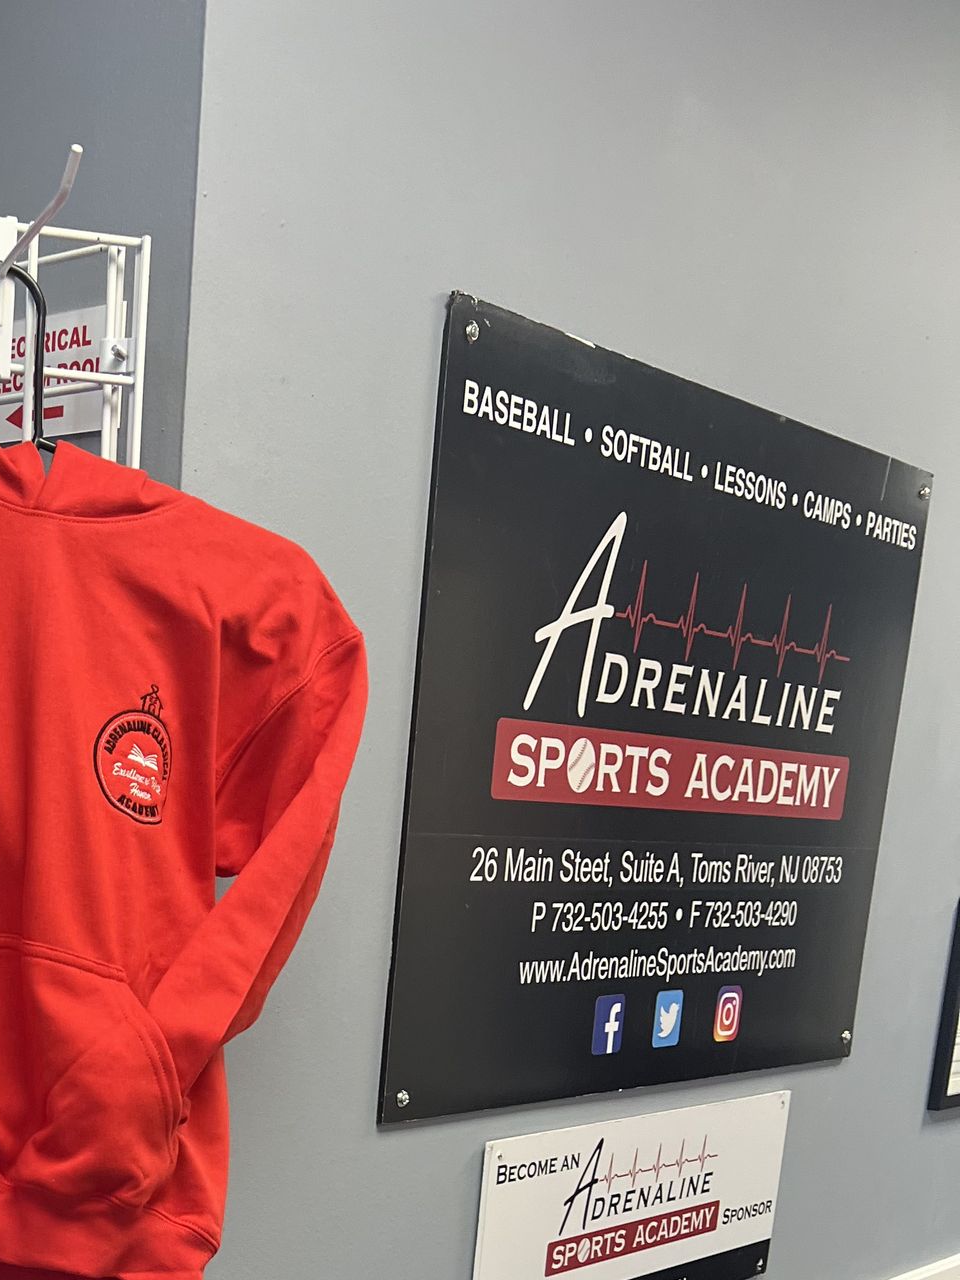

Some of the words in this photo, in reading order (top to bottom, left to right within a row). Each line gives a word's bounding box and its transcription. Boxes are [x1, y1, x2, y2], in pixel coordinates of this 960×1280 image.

[463, 379, 575, 446] BASEBALL
[600, 425, 693, 482] SOFTBALL
[714, 461, 786, 510] LESSONS
[803, 491, 851, 530] CAMPS
[866, 511, 917, 551] PARTIES
[523, 511, 841, 735] ADRENALINE
[507, 733, 672, 797] SPORTS
[684, 753, 840, 808] ACADEMY
[470, 847, 498, 882] 26
[504, 848, 554, 882] Main
[560, 849, 613, 887] Steet,
[620, 850, 665, 883] Suite
[666, 852, 684, 888] A,
[691, 853, 731, 883] Toms
[735, 854, 775, 887] River,
[779, 855, 800, 883] NJ
[802, 856, 842, 884] 08753
[531, 902, 546, 932] P
[551, 902, 668, 932] 732-503-4255
[690, 901, 703, 928] F
[704, 901, 798, 928] 732-503-4290
[519, 945, 796, 984] www.AdrenalineSportsAcademy.com
[496, 1157, 558, 1185] BECOME
[560, 1153, 581, 1173] AN
[559, 1137, 714, 1236] ADRENALINE
[551, 1229, 627, 1270] SPORTS
[632, 1206, 716, 1249] ACADEMY
[722, 1200, 772, 1225] SPONSOR
